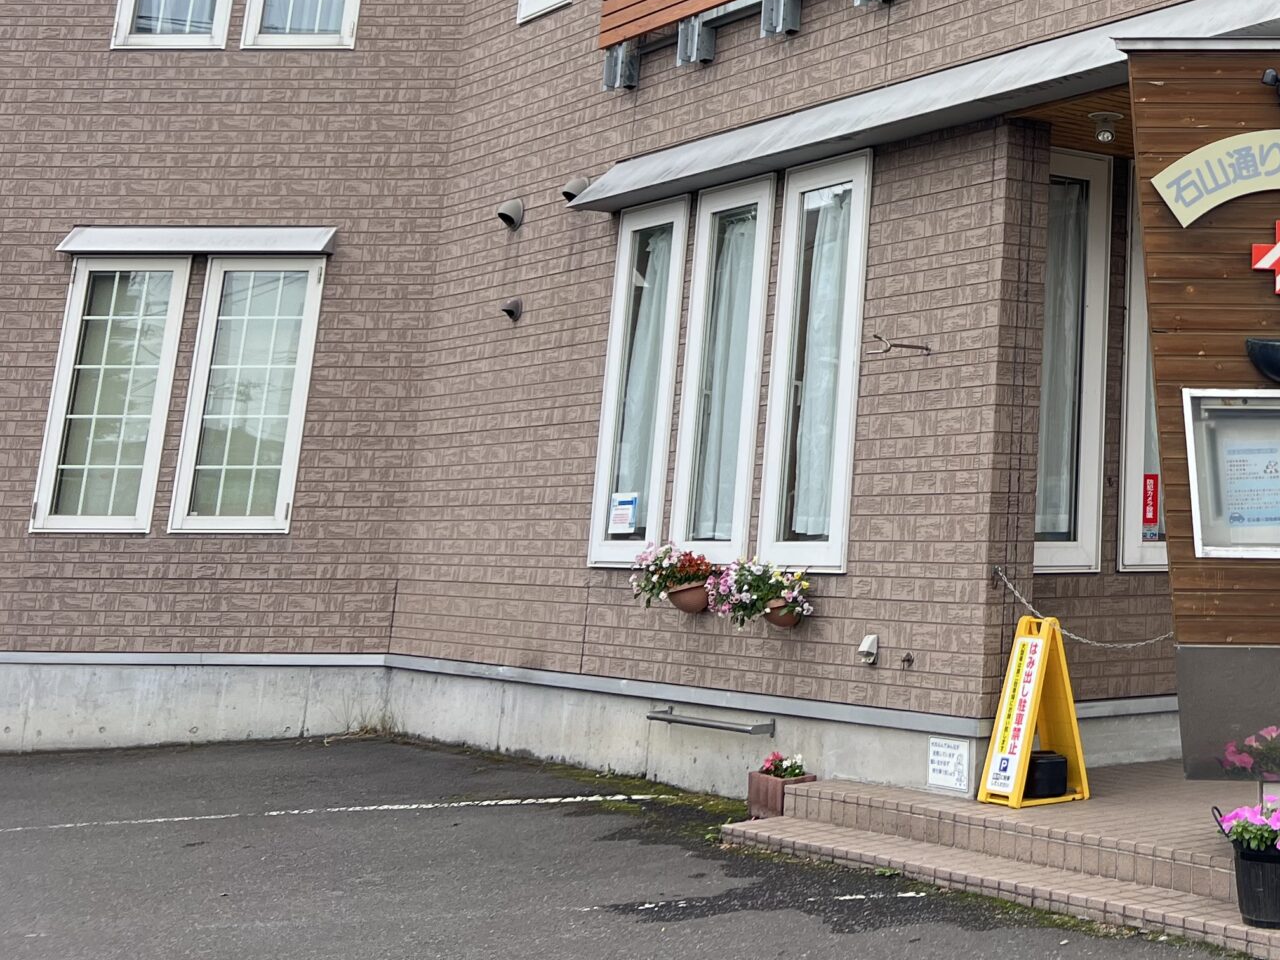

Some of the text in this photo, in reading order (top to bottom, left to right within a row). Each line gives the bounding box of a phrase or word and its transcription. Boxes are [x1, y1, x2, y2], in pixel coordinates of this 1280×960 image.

[1008, 642, 1039, 756] はみ出し駐車禁止
